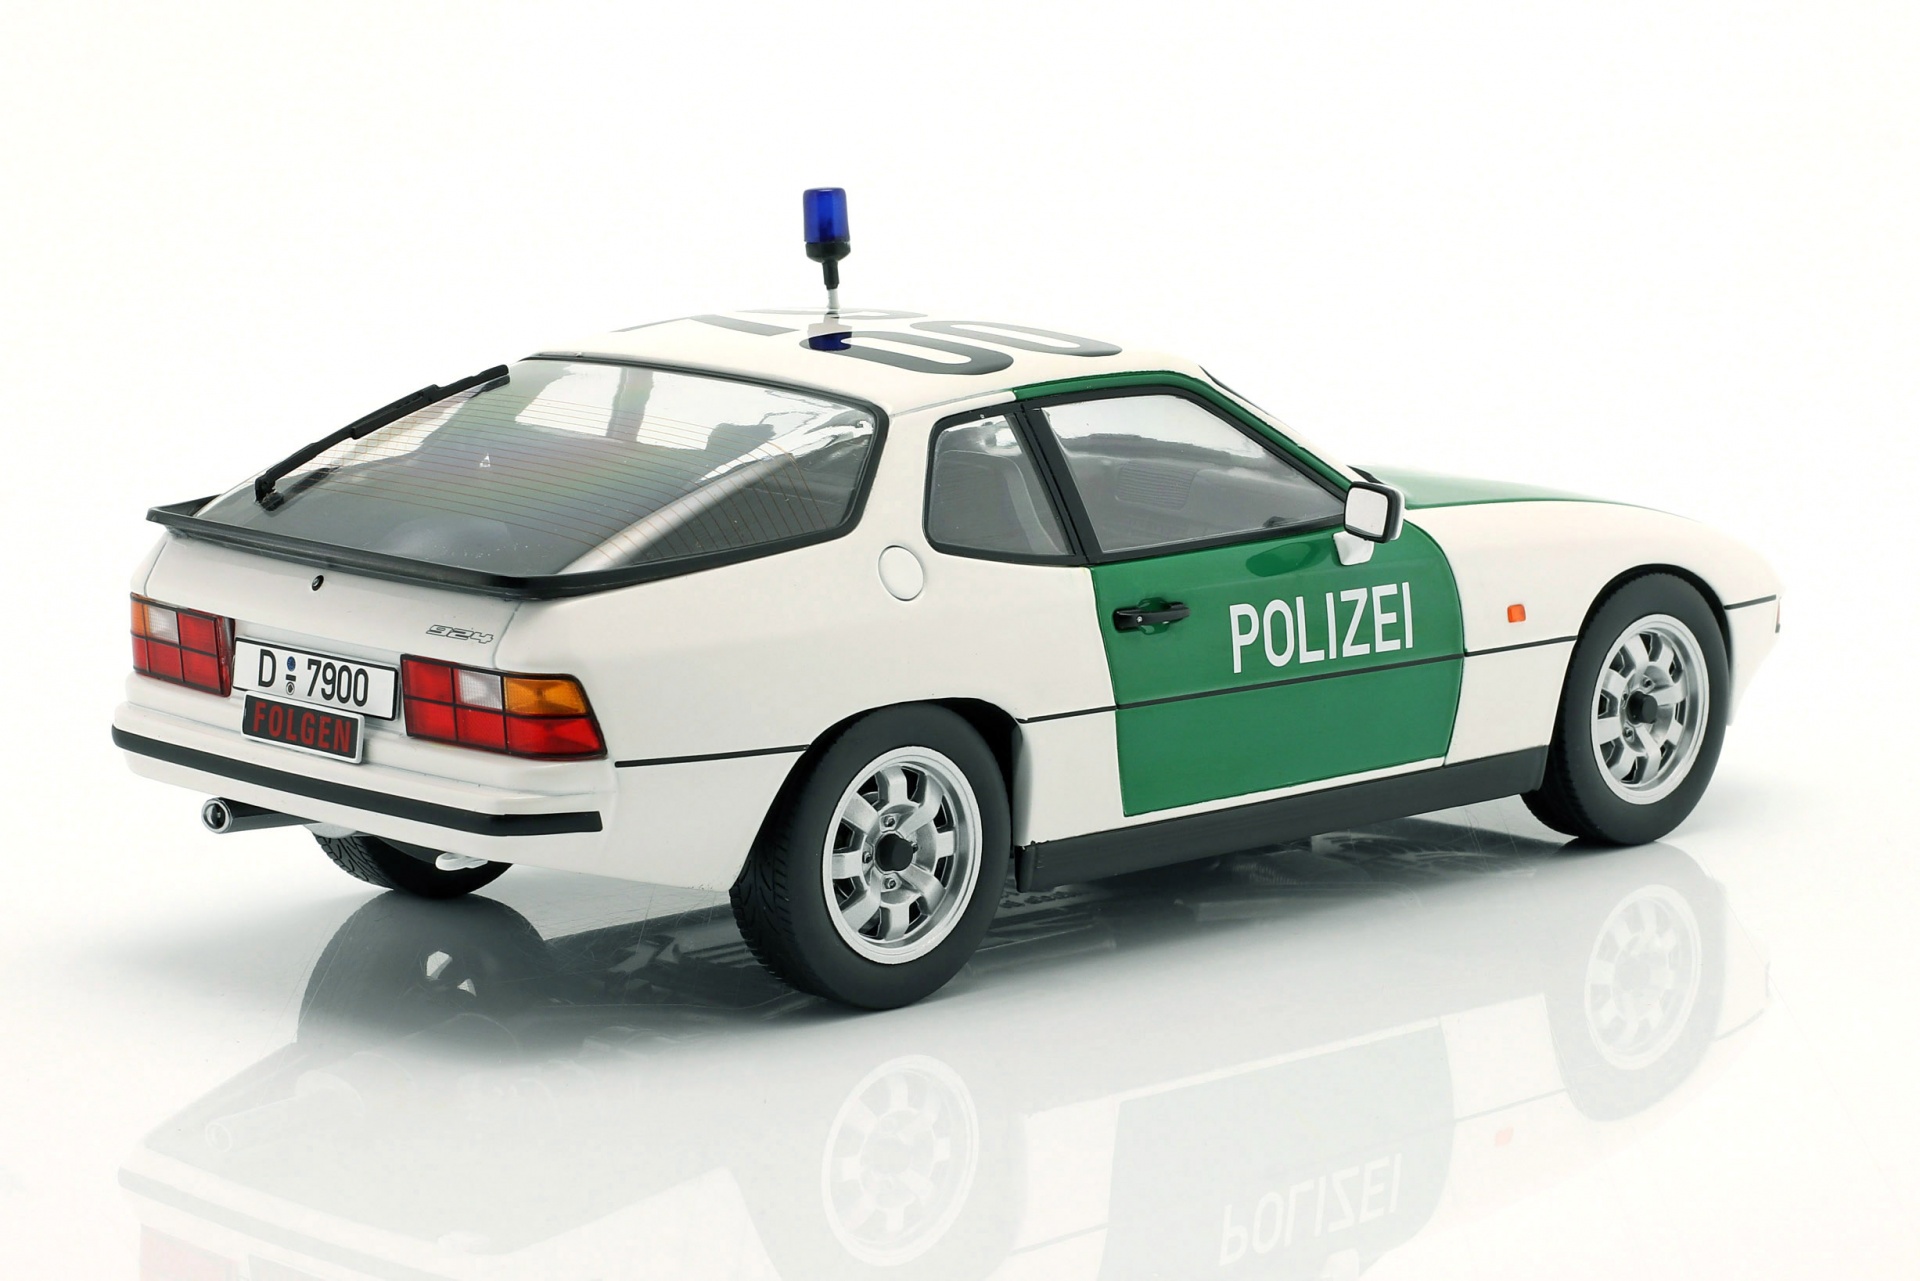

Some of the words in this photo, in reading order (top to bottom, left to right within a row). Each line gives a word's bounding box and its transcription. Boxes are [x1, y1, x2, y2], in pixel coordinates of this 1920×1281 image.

[426, 624, 494, 644] 924
[1229, 582, 1413, 674] POLIZEI
[258, 648, 277, 688] D
[307, 658, 369, 707] 7900
[253, 701, 352, 753] FOLGEN
